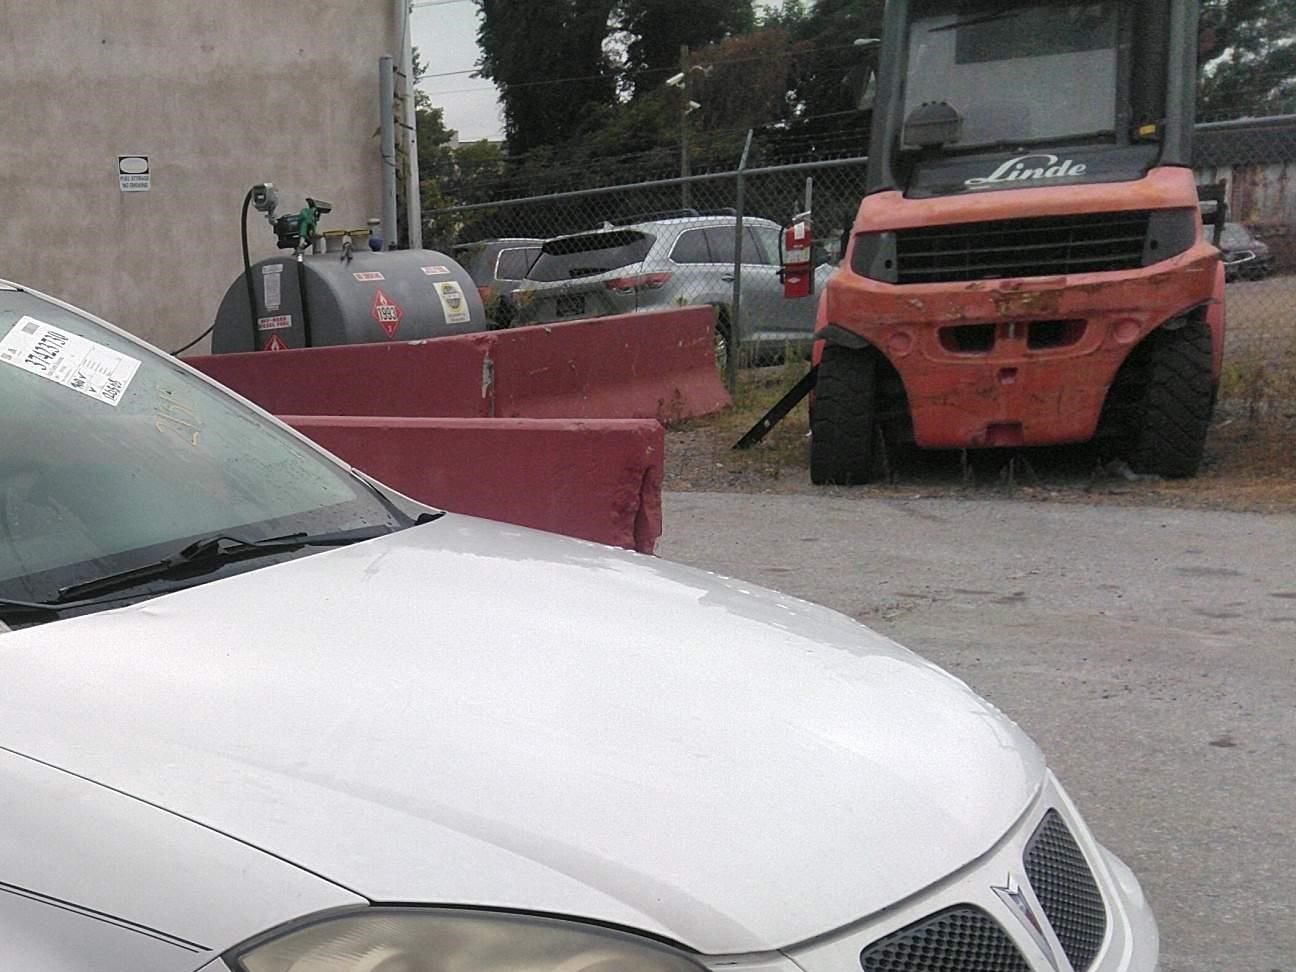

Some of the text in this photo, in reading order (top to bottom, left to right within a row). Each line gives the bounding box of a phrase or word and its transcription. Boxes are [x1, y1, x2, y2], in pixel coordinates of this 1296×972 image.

[964, 154, 1088, 185] Linde
[377, 306, 397, 321] 1993
[25, 330, 69, 371] 37423730
